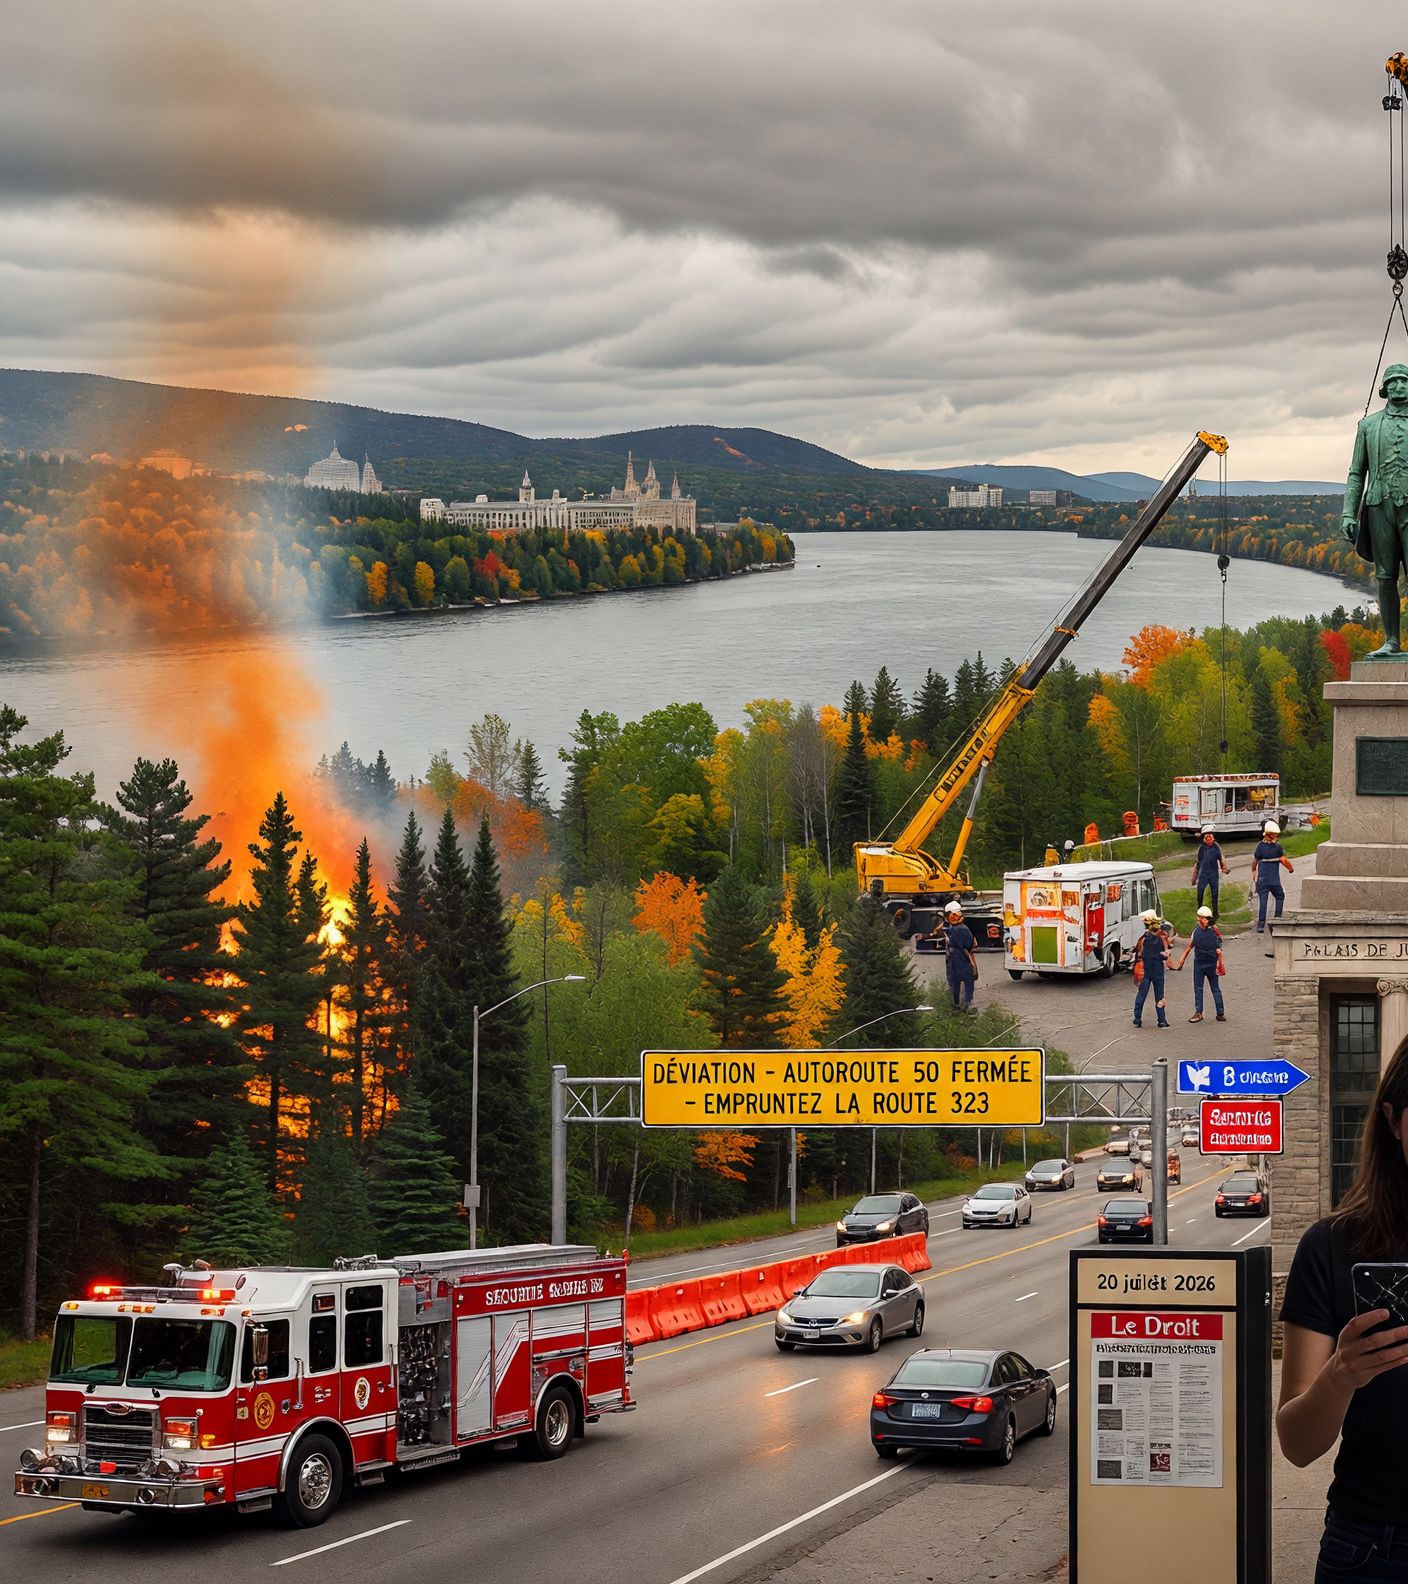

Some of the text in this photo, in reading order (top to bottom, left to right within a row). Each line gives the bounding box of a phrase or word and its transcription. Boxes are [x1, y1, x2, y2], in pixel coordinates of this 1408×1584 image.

[1367, 943, 1387, 957] DE
[653, 1057, 755, 1084] DÉVIATION
[783, 1061, 899, 1083] AUTOROUTE
[914, 1061, 939, 1083] 50
[951, 1055, 1032, 1082] FERMÉE
[704, 1093, 822, 1114] EMPRUNTEZ
[836, 1093, 860, 1114] LA
[873, 1092, 937, 1113] ROUTE
[951, 1092, 989, 1113] 323
[1097, 1274, 1118, 1290] 20
[1174, 1274, 1216, 1291] 2026
[1111, 1315, 1200, 1336] Le Droit
